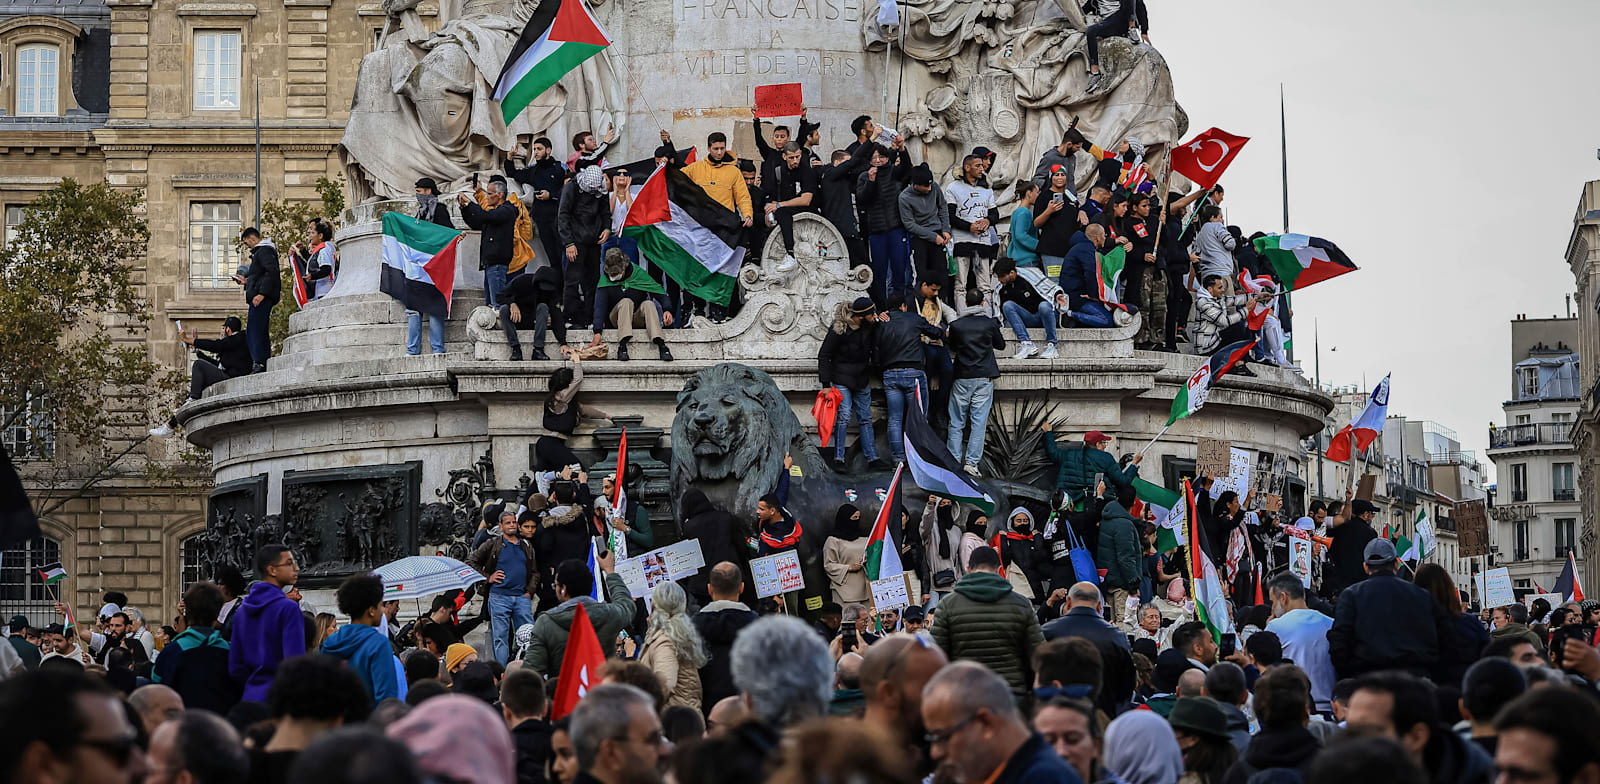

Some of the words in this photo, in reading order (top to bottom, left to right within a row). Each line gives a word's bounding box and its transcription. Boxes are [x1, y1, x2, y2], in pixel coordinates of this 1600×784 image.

[680, 0, 858, 22] FRANÇAISE
[758, 29, 784, 49] LA
[685, 56, 747, 76] VILLE
[757, 55, 787, 75] DE
[796, 56, 857, 78] PARIS
[1491, 504, 1538, 521] BRISTOL
